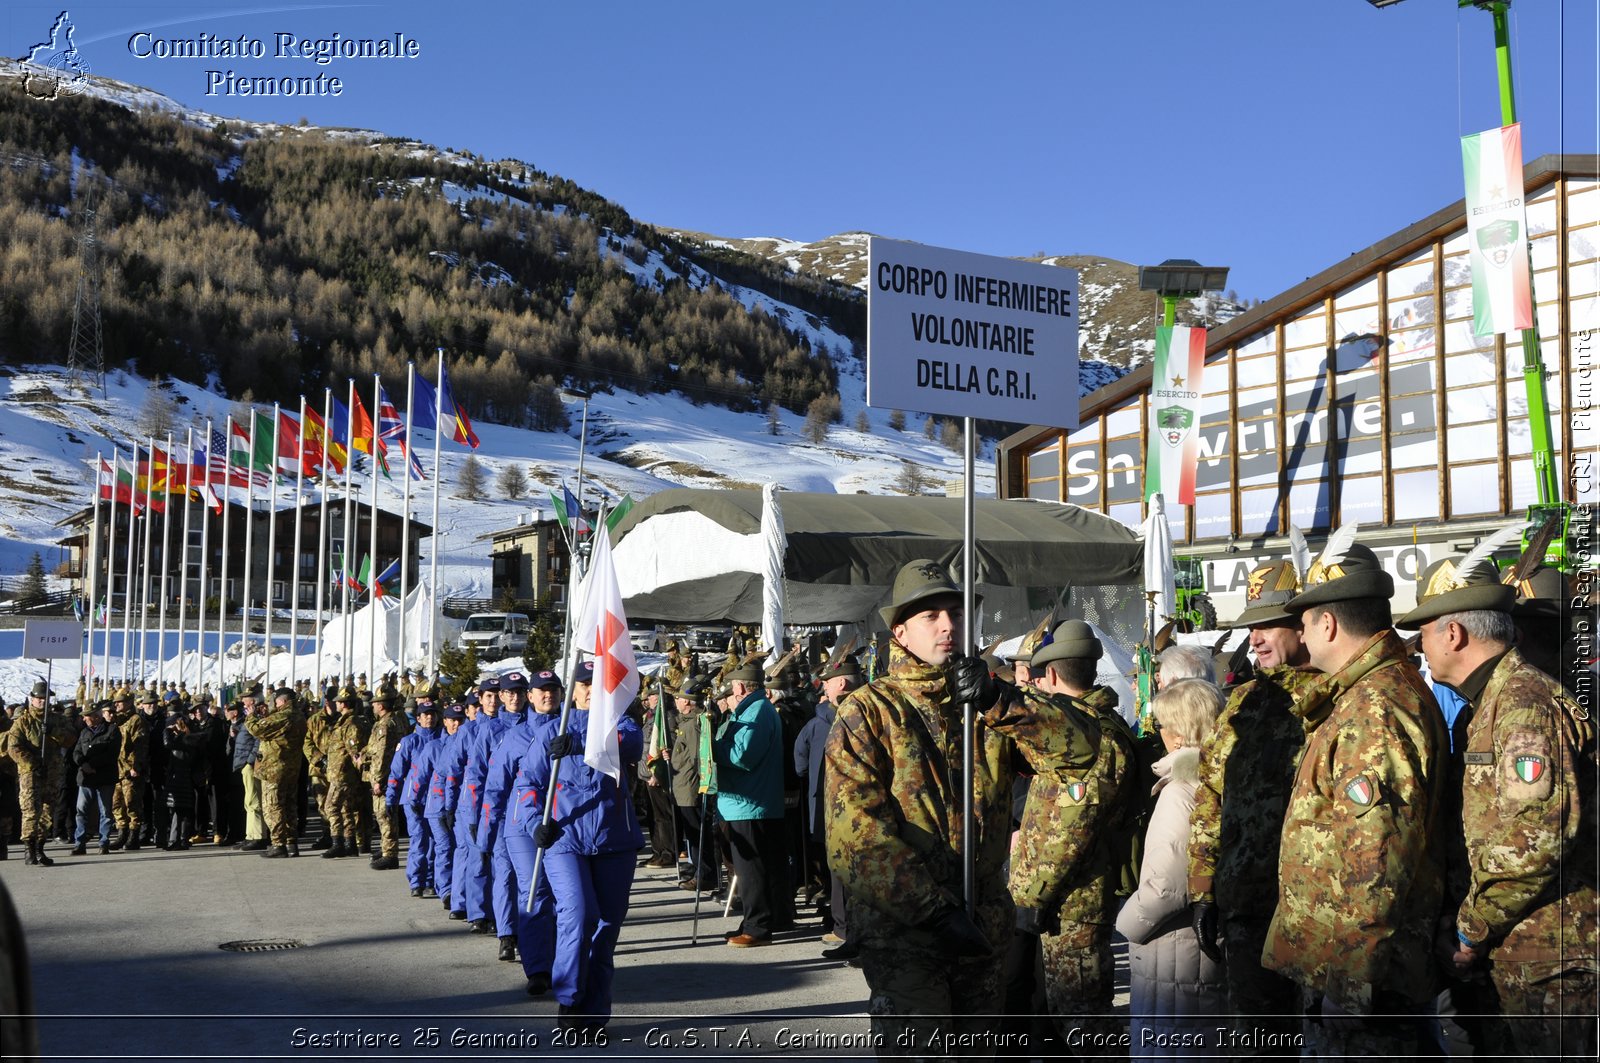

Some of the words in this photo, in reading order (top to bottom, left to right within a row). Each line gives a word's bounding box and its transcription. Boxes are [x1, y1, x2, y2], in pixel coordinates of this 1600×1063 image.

[1473, 198, 1520, 216] ESERCITO
[878, 262, 947, 299] CORPO
[955, 274, 1071, 317] INFERMIERE
[912, 313, 1034, 355] VOLONTARIE
[917, 359, 980, 393] DELLA
[987, 368, 1036, 400] C.R.I.
[1157, 389, 1198, 399] ESERCITO
[1067, 395, 1416, 498] Snwtime.
[1518, 756, 1541, 764] ITALIA
